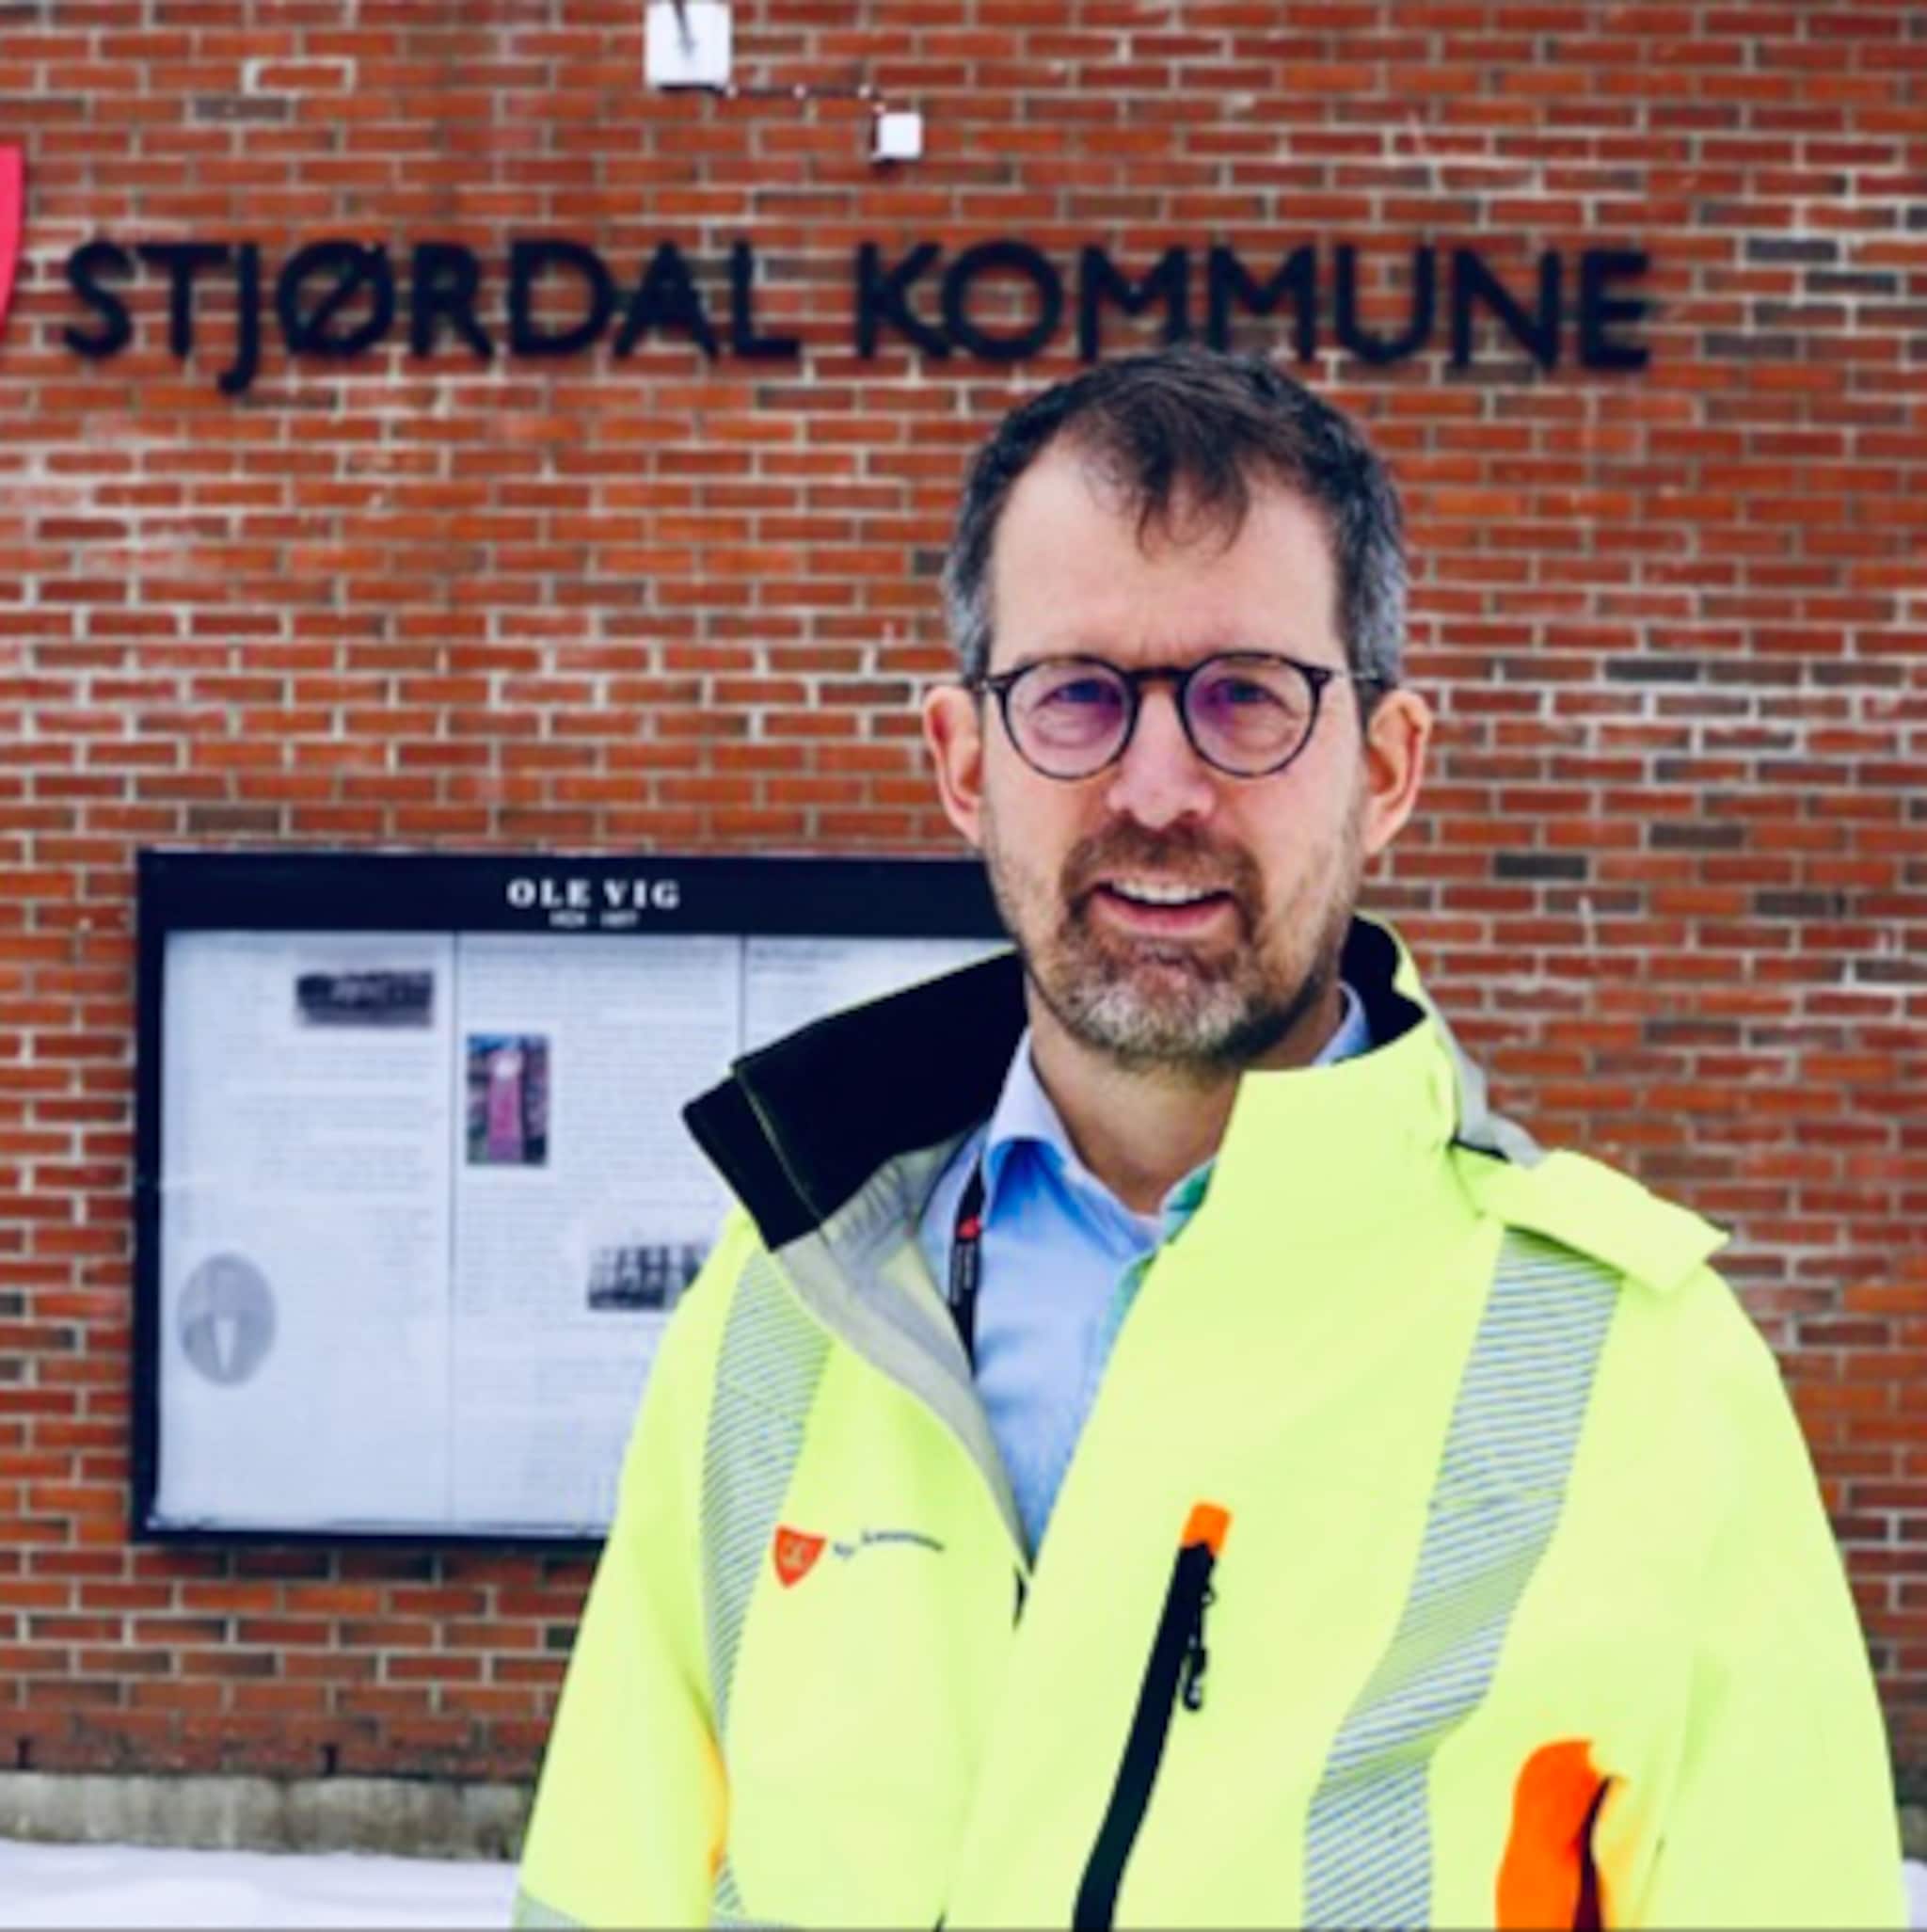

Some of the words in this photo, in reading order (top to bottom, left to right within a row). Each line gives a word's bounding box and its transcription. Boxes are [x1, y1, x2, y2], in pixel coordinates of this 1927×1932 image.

[63, 239, 802, 395] STJØRDAL
[853, 239, 1650, 371] KOMMUNE
[507, 879, 591, 909] OLE
[603, 879, 679, 909] VIG
